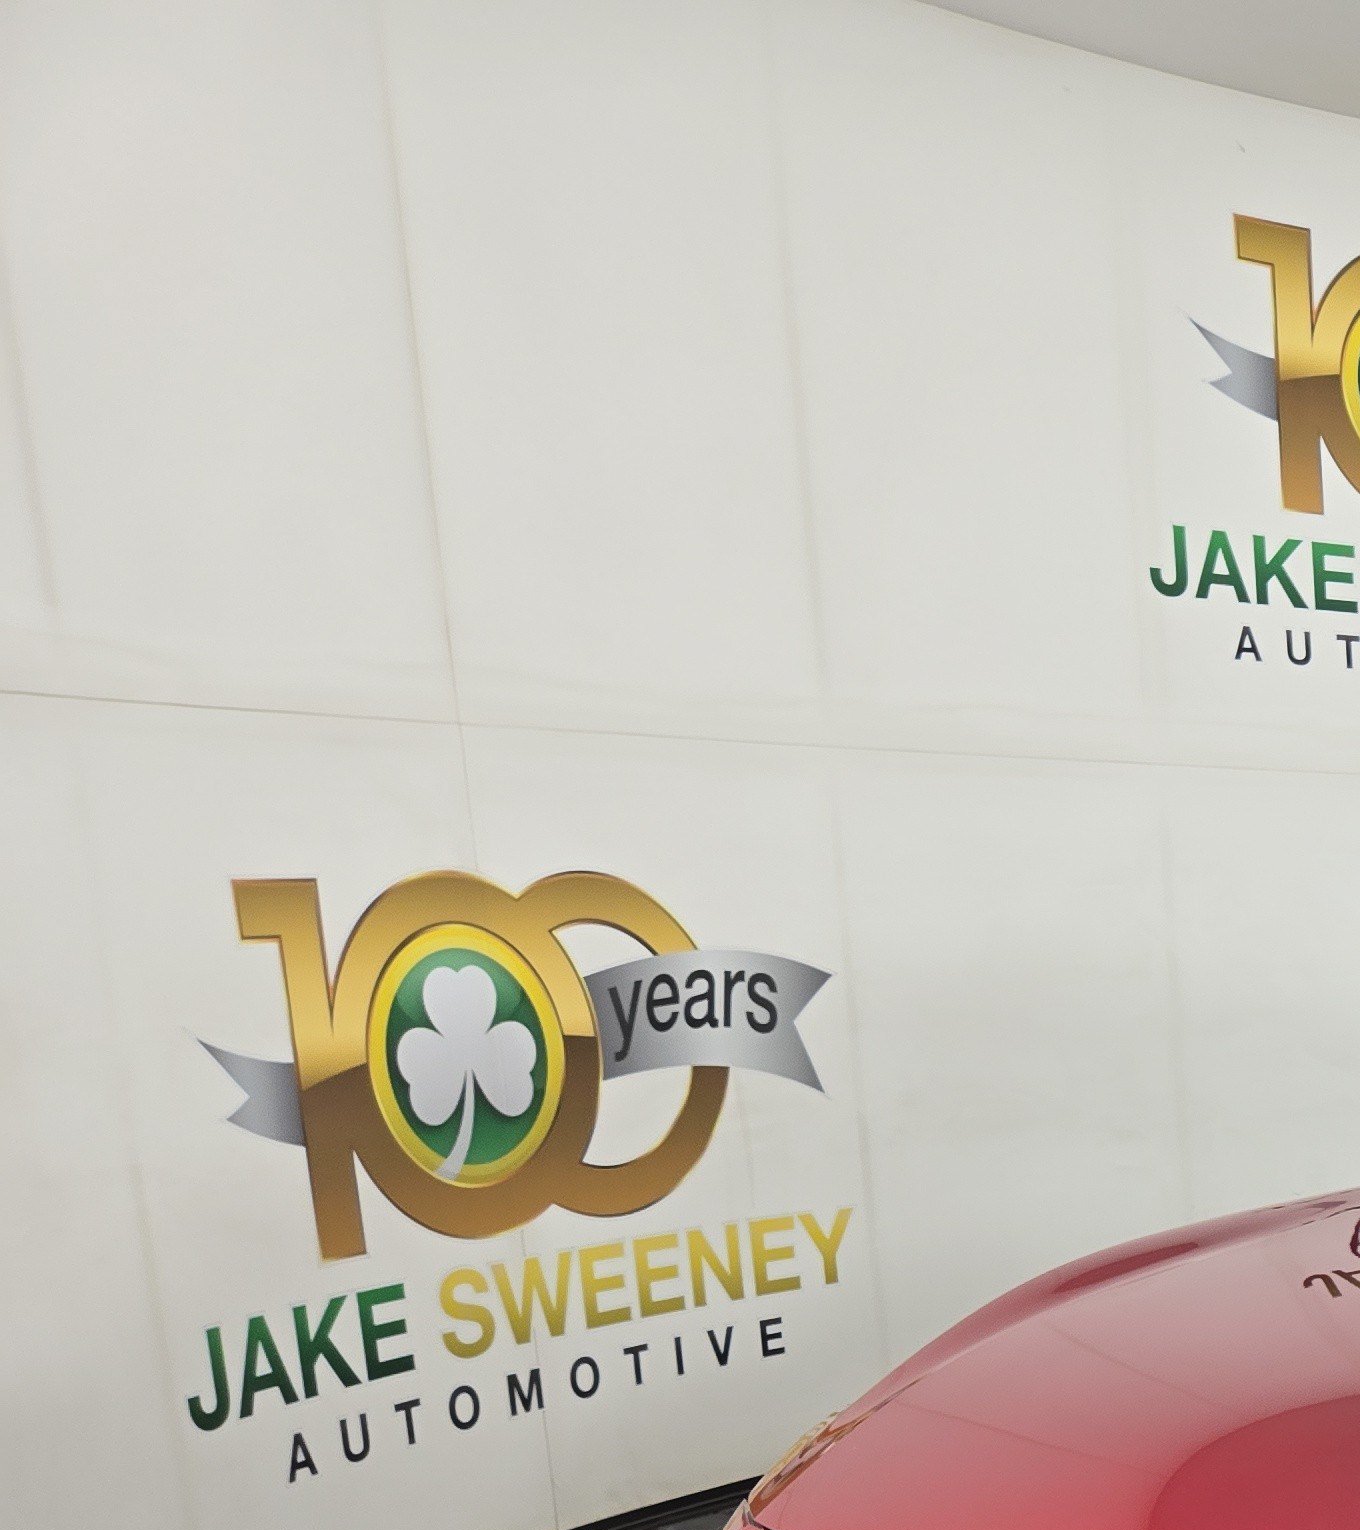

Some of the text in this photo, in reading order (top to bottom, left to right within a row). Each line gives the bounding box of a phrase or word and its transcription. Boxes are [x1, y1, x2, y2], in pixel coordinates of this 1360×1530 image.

[1148, 523, 1359, 614] JAKE
[606, 969, 779, 1063] years
[186, 1207, 854, 1433] JAKE SWEENEY
[286, 1316, 786, 1484] AUTOMOTIVE
